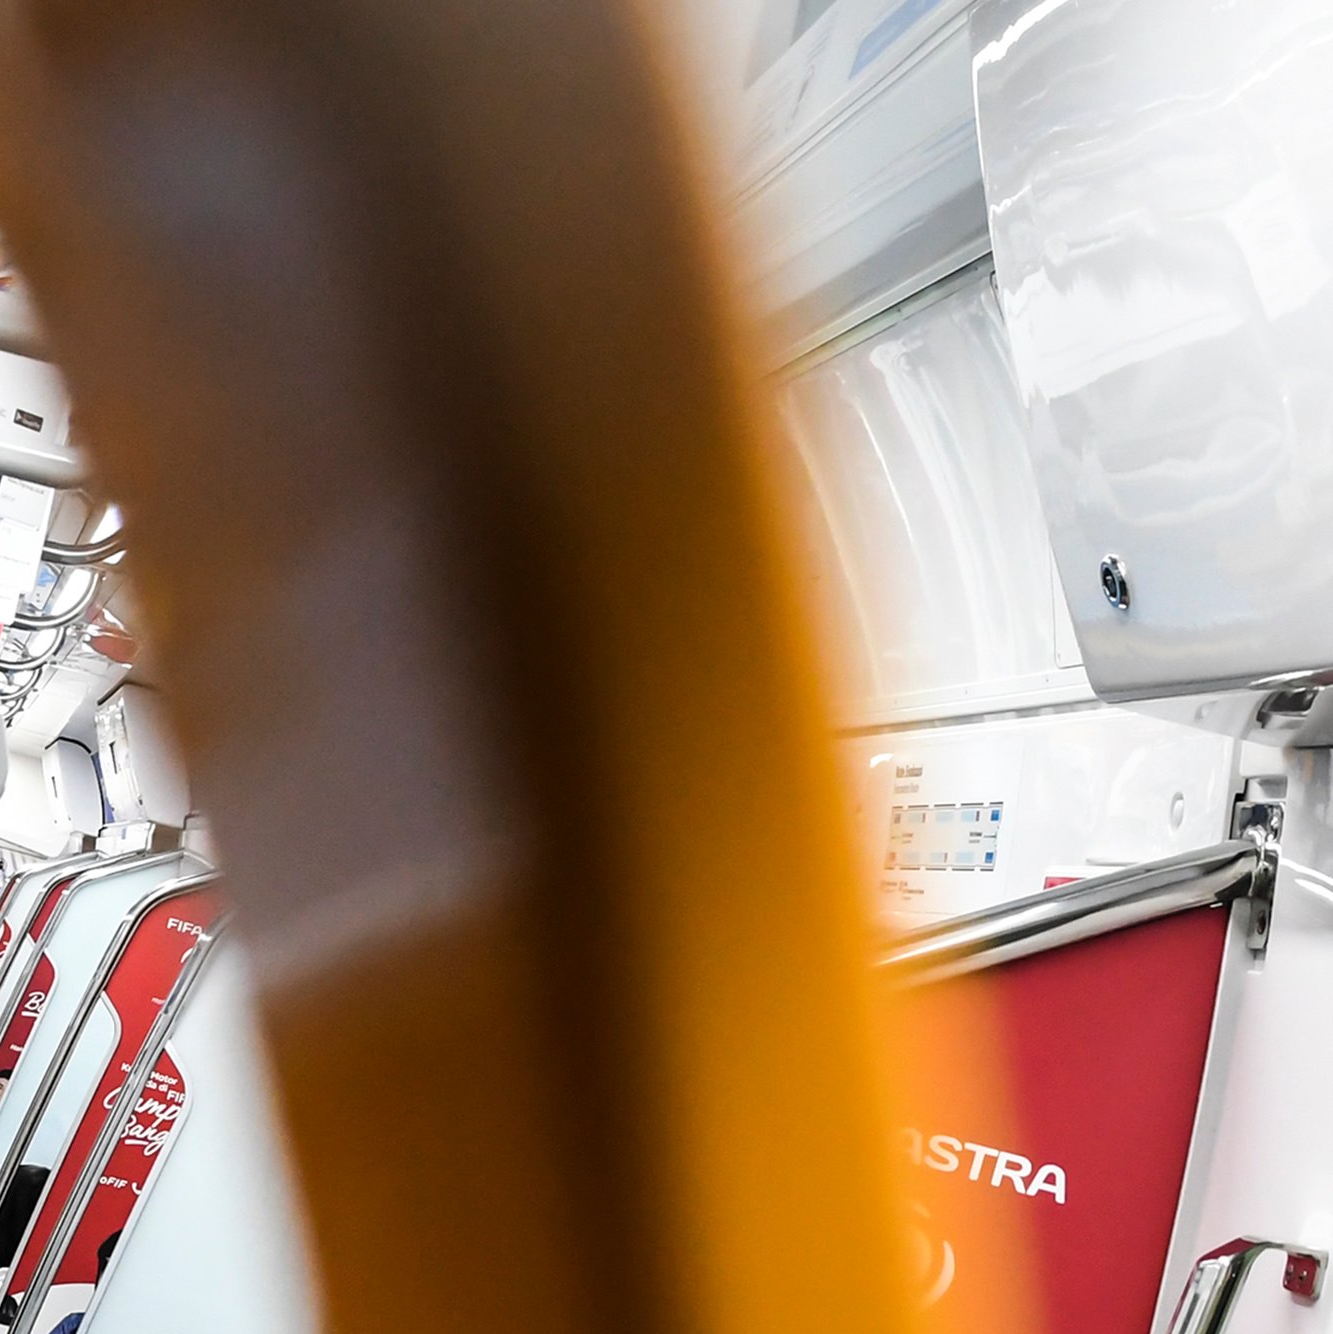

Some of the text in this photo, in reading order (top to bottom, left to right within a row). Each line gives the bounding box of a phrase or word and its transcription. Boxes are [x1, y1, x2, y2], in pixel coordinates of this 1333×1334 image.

[167, 917, 203, 936] FIFA
[150, 1071, 178, 1086] Motor
[158, 1083, 169, 1093] di
[901, 1127, 1066, 1205] ASTRA
[100, 1175, 128, 1189] oFIF
